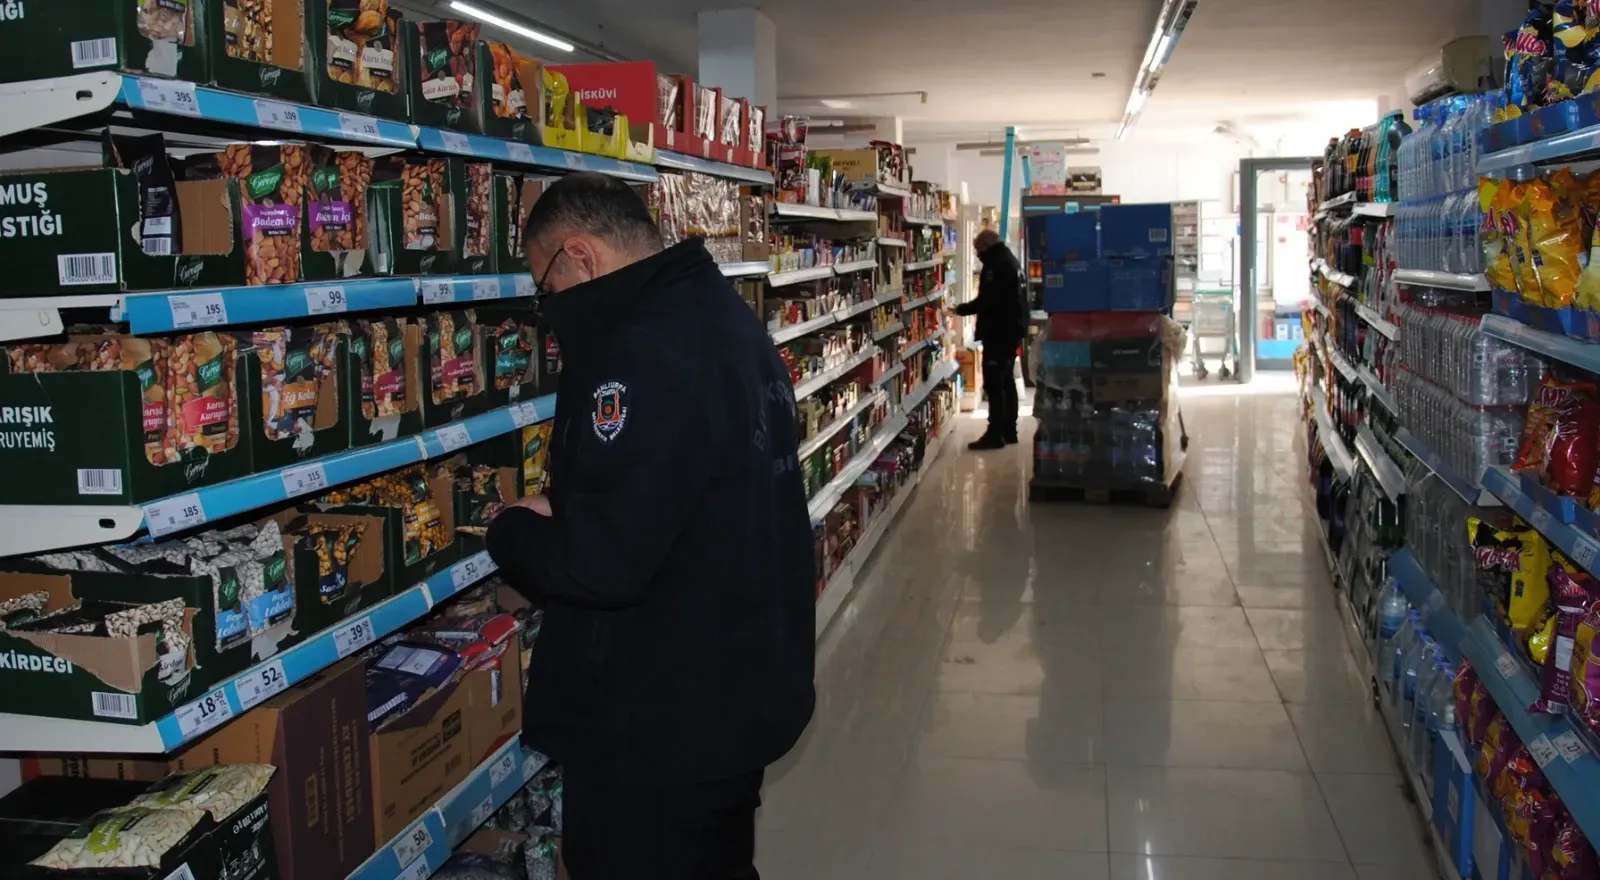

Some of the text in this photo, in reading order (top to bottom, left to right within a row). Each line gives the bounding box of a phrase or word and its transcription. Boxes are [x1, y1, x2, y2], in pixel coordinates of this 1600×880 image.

[175, 91, 192, 103] 395
[581, 87, 617, 100] İSKÜVİ
[284, 110, 297, 121] 109
[0, 209, 63, 238] STIĞI
[254, 215, 284, 227] Badem
[438, 284, 448, 295] 99
[329, 291, 342, 304] 99
[206, 304, 221, 315] 195
[308, 471, 321, 483] 115
[183, 505, 199, 517] 185
[465, 562, 476, 576] 52
[350, 625, 363, 641] 39
[262, 667, 278, 686] 52
[198, 697, 217, 718] 18
[412, 831, 426, 847] 50
